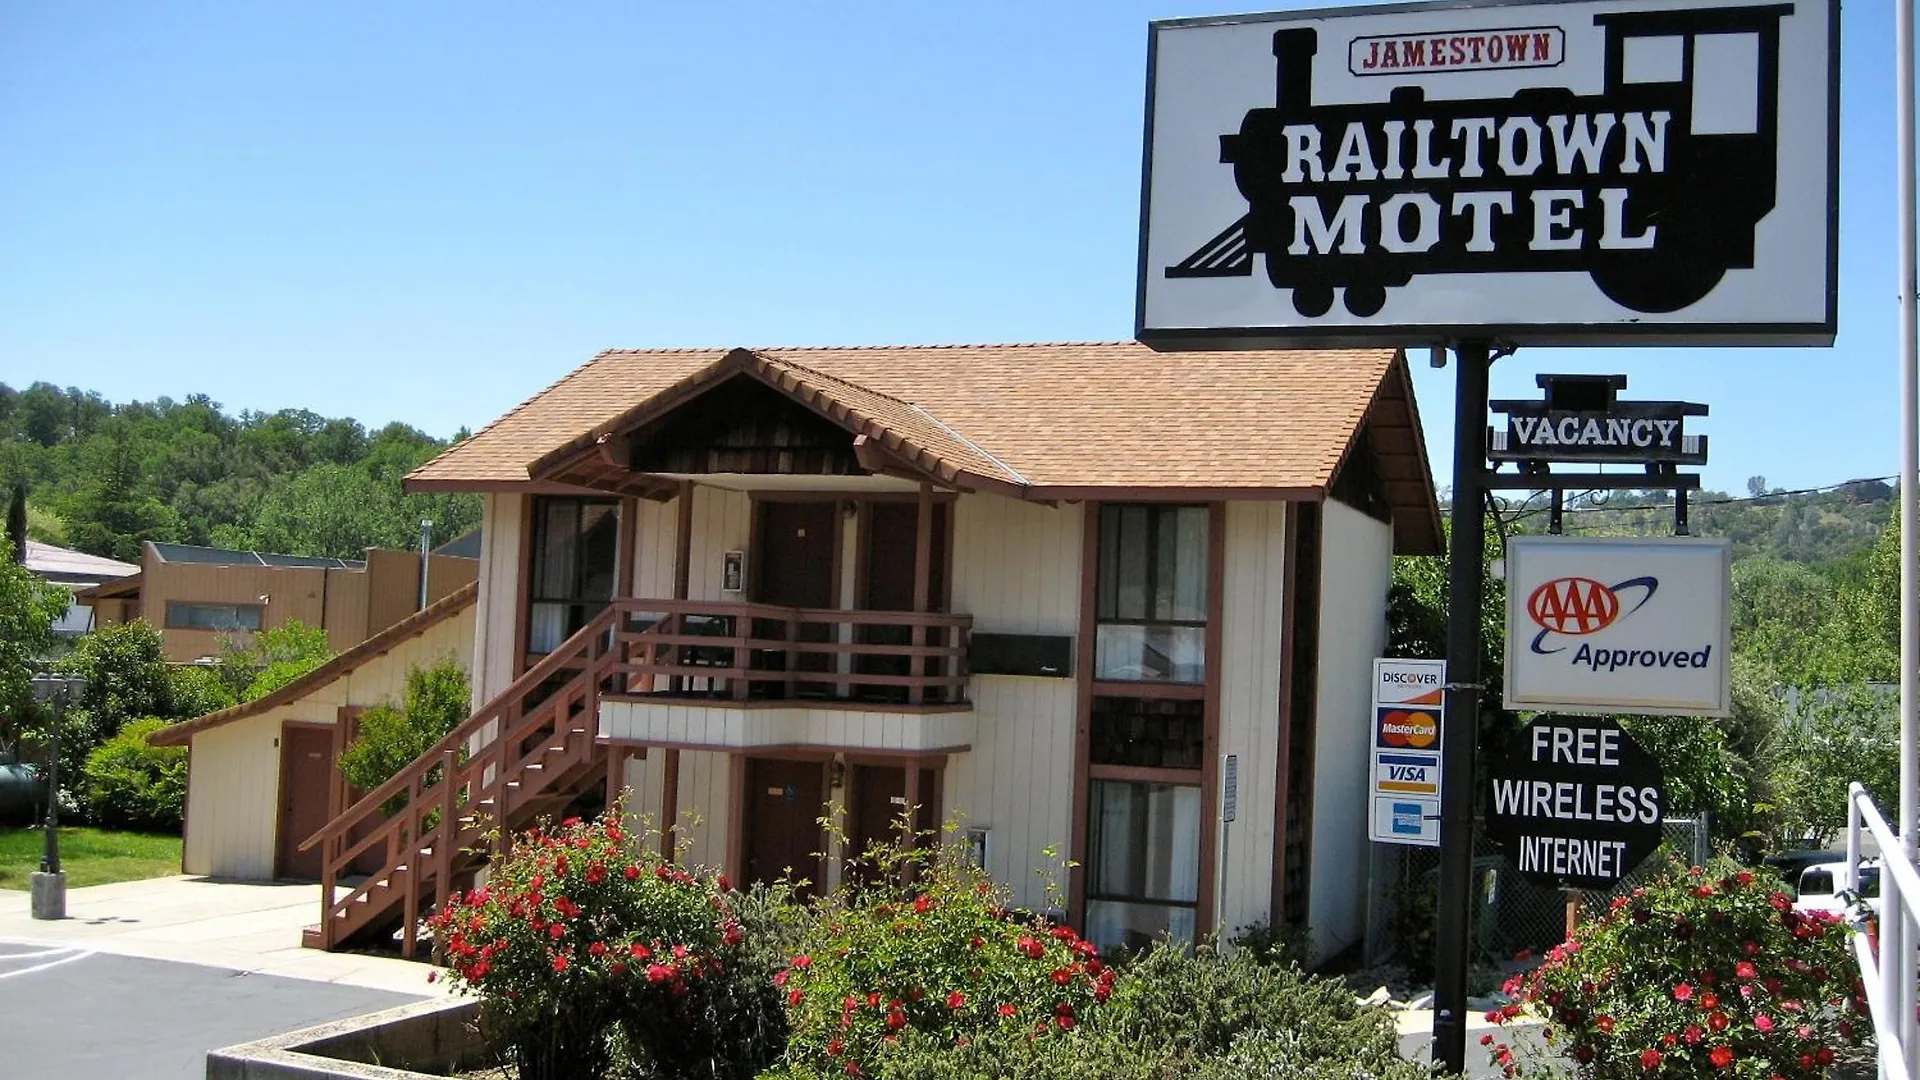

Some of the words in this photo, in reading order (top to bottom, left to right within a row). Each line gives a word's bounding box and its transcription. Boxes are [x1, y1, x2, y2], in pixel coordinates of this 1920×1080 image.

[1363, 33, 1551, 69] JAMESTOWN
[1281, 111, 1671, 182] RAILTOWN
[1288, 188, 1658, 254] MOTEL
[1512, 416, 1679, 447] VACANCY
[1538, 578, 1611, 634] AAA
[1572, 643, 1712, 672] Approved
[1383, 672, 1437, 685] DISCOVER
[1382, 722, 1436, 736] MasterCard
[1532, 725, 1620, 766] FREE
[1389, 765, 1426, 782] VISA
[1493, 778, 1659, 824] WIRELESS
[1519, 835, 1626, 878] INTERNET
